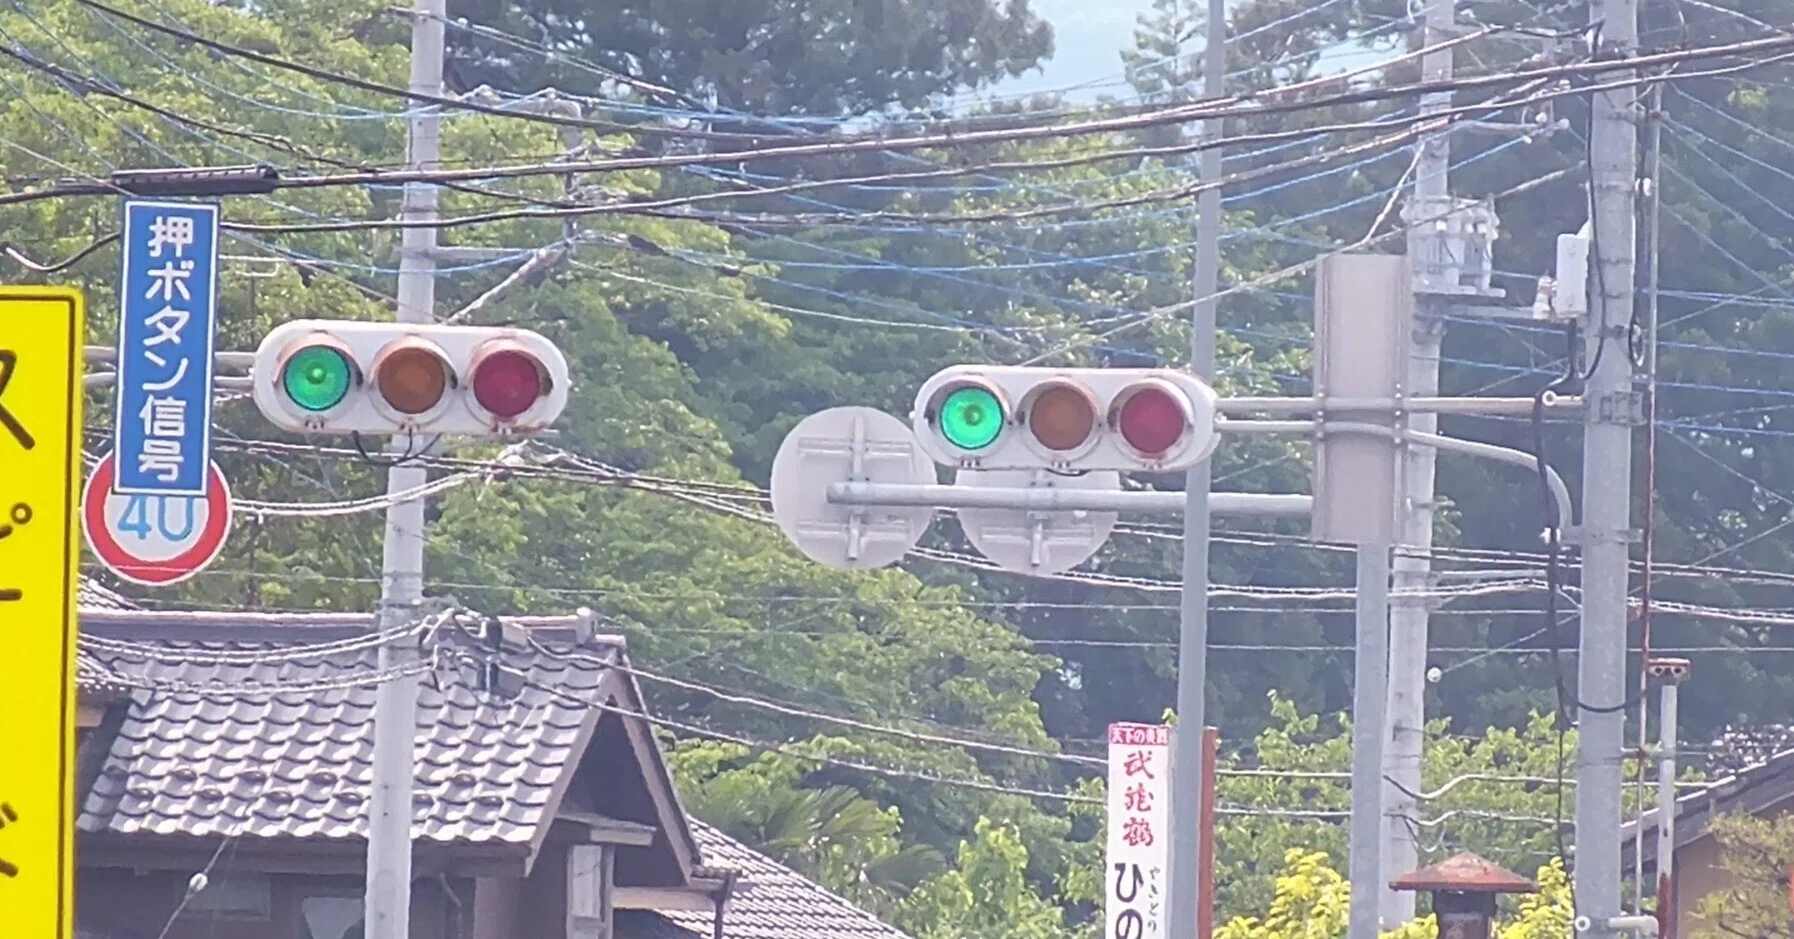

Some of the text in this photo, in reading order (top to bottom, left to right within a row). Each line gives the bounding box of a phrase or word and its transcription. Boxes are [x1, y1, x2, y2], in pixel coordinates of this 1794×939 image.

[139, 216, 194, 481] 押ボタン信号
[118, 493, 194, 541] 40
[1114, 863, 1144, 939] ひの
[1147, 867, 1160, 933] やきとり
